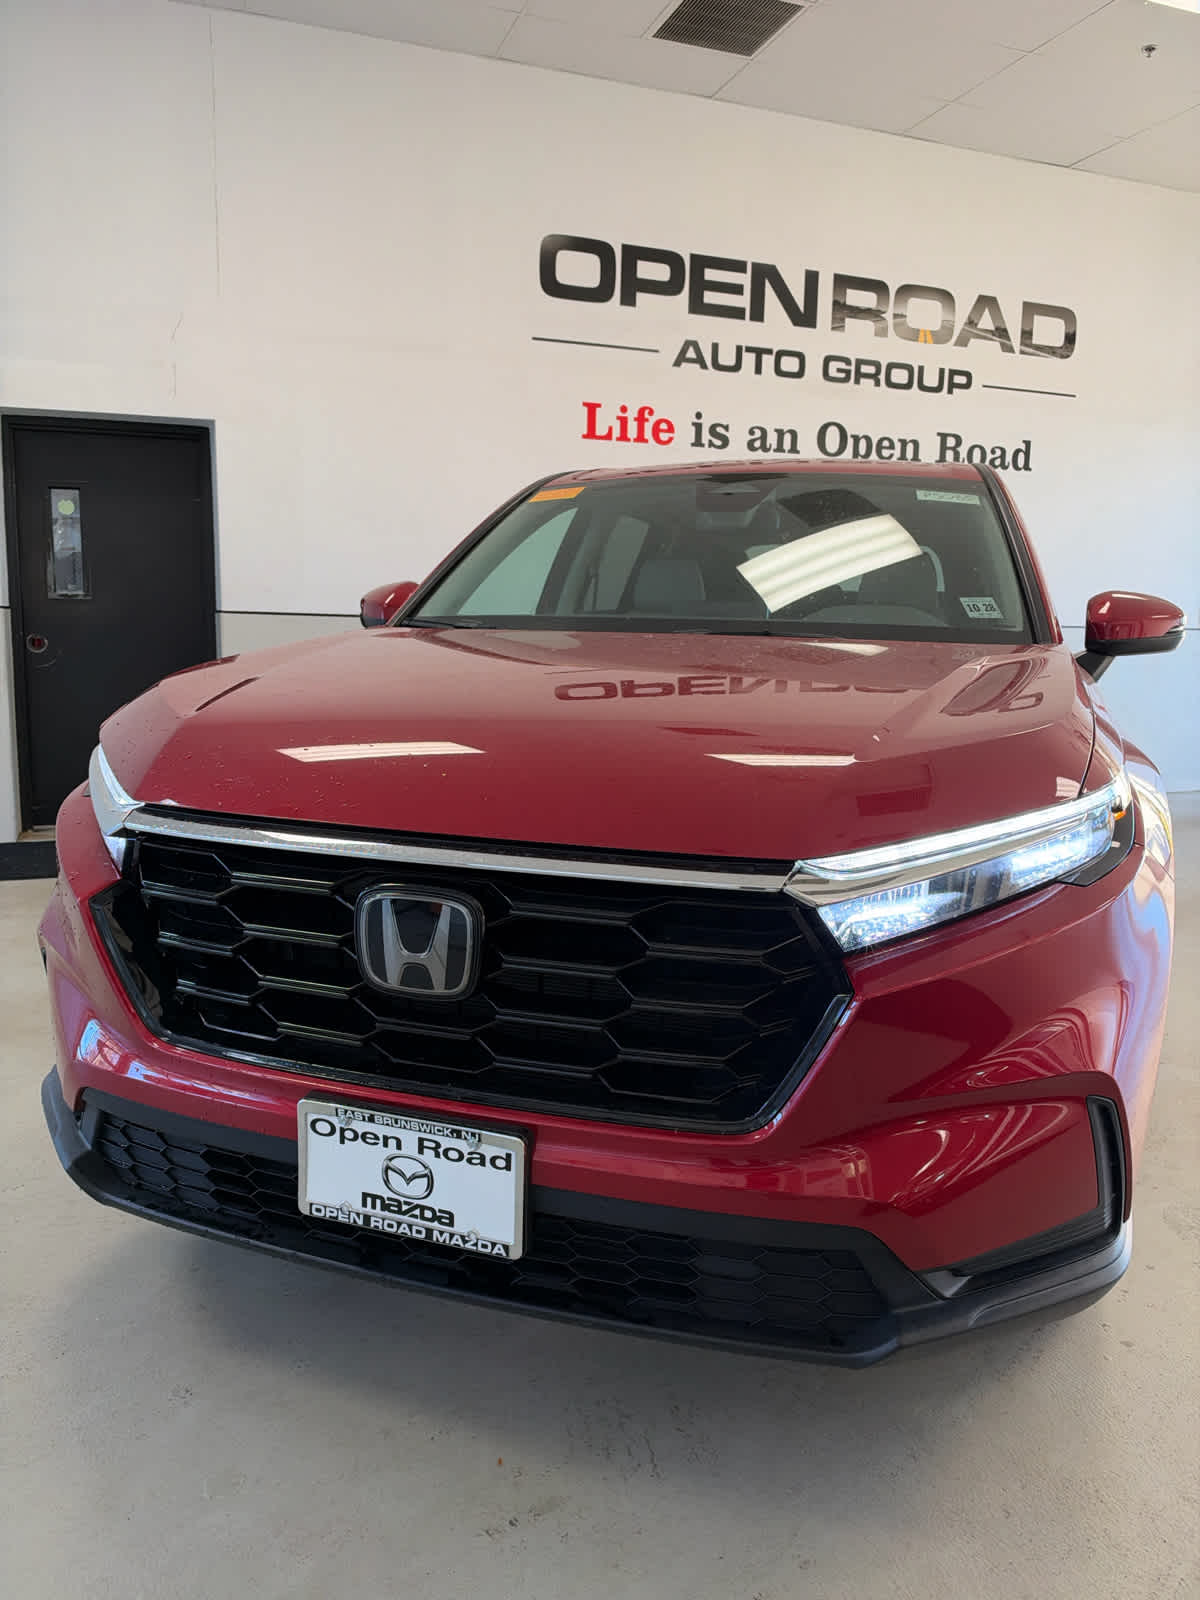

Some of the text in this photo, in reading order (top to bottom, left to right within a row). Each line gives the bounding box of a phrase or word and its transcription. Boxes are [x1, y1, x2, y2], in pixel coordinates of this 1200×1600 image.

[539, 233, 1077, 360] OPEN ROAD
[672, 339, 973, 395] AUTO GROUP
[581, 402, 1033, 472] Life is an Open Road
[310, 1118, 512, 1172] Open Road
[338, 1109, 480, 1142] EAST BRUNSWICK, NJ
[311, 1203, 507, 1257] OPEN ROAD MAZDA
